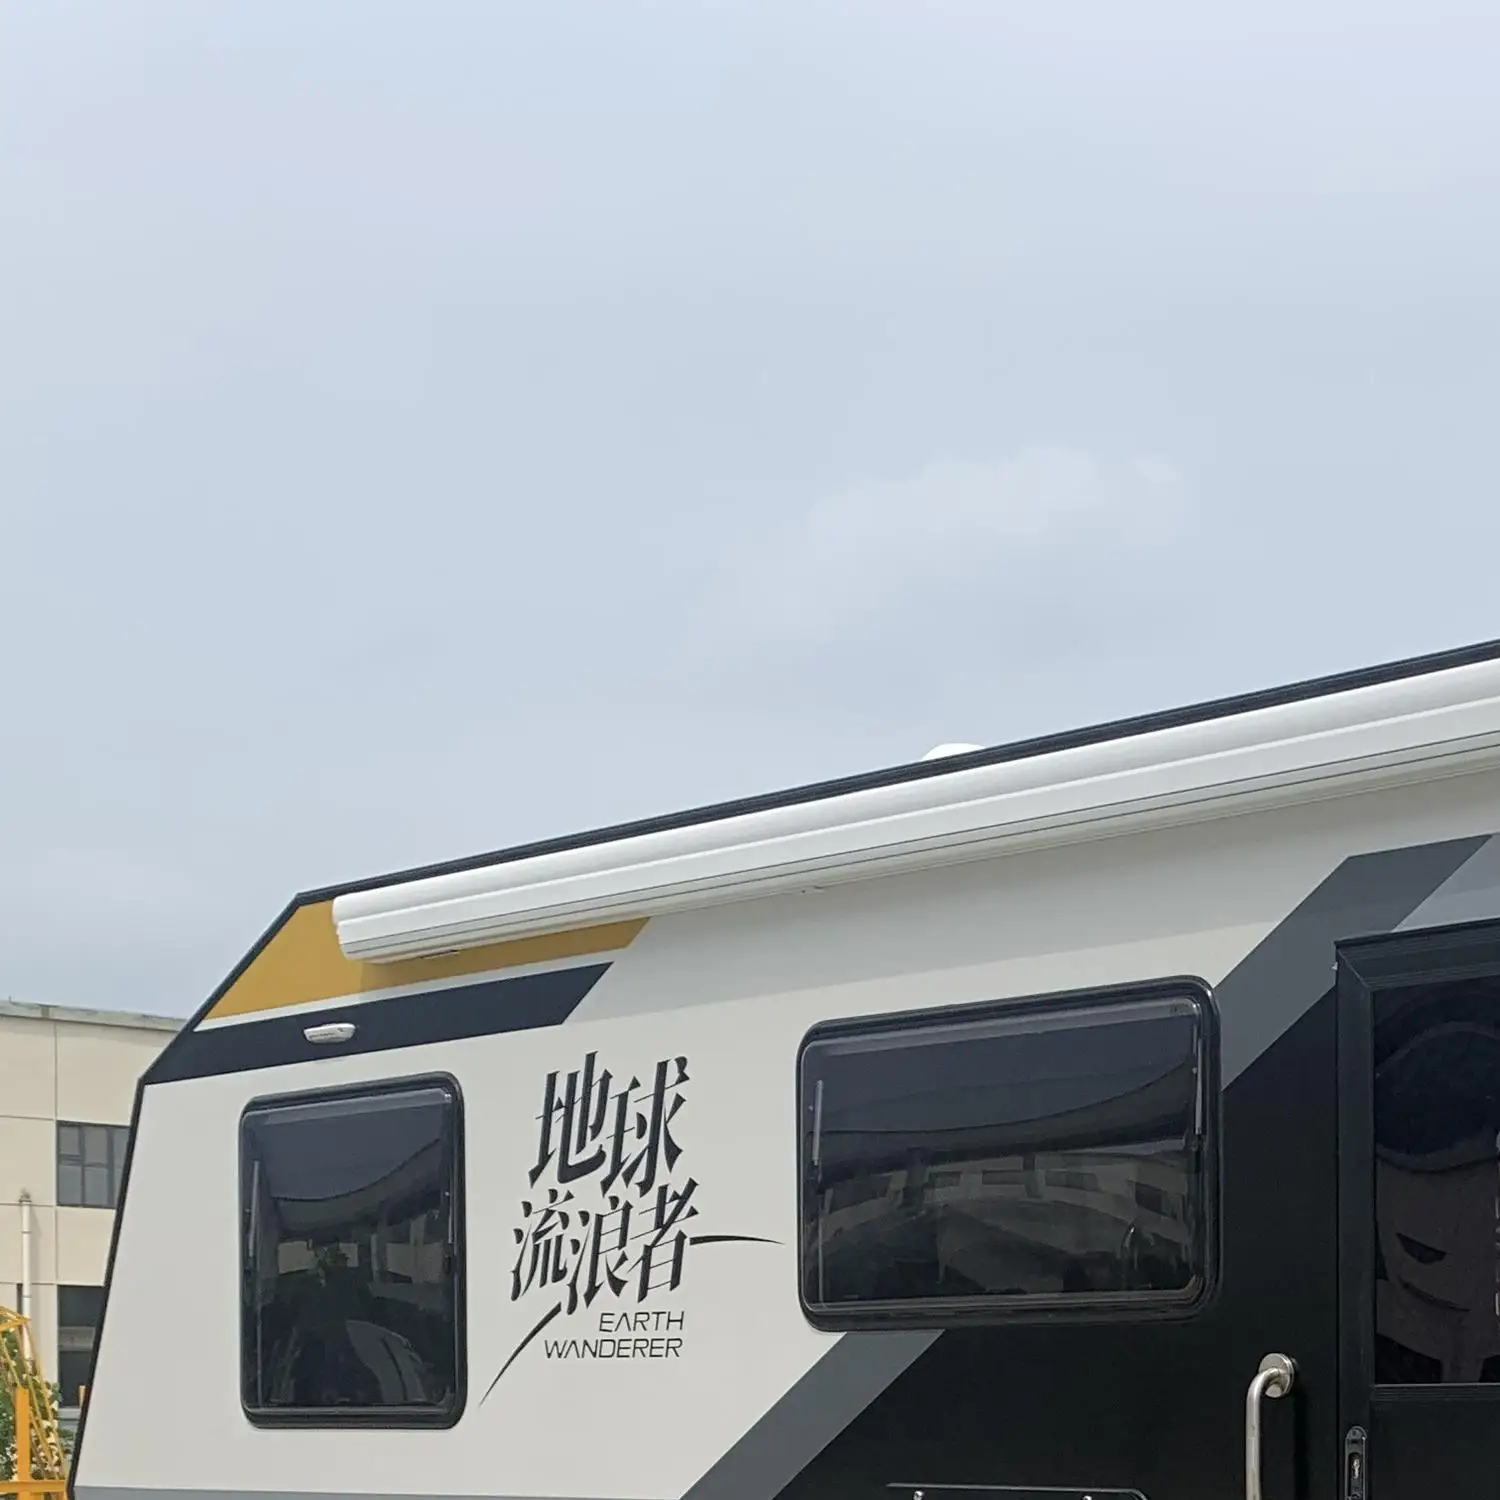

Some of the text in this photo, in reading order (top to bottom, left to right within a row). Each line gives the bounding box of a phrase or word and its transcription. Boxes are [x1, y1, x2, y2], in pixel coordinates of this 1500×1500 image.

[528, 1051, 691, 1198] 地球
[510, 1177, 700, 1315] 流浪者
[544, 1338, 683, 1359] WANDERER
[599, 1311, 685, 1332] EARTH
